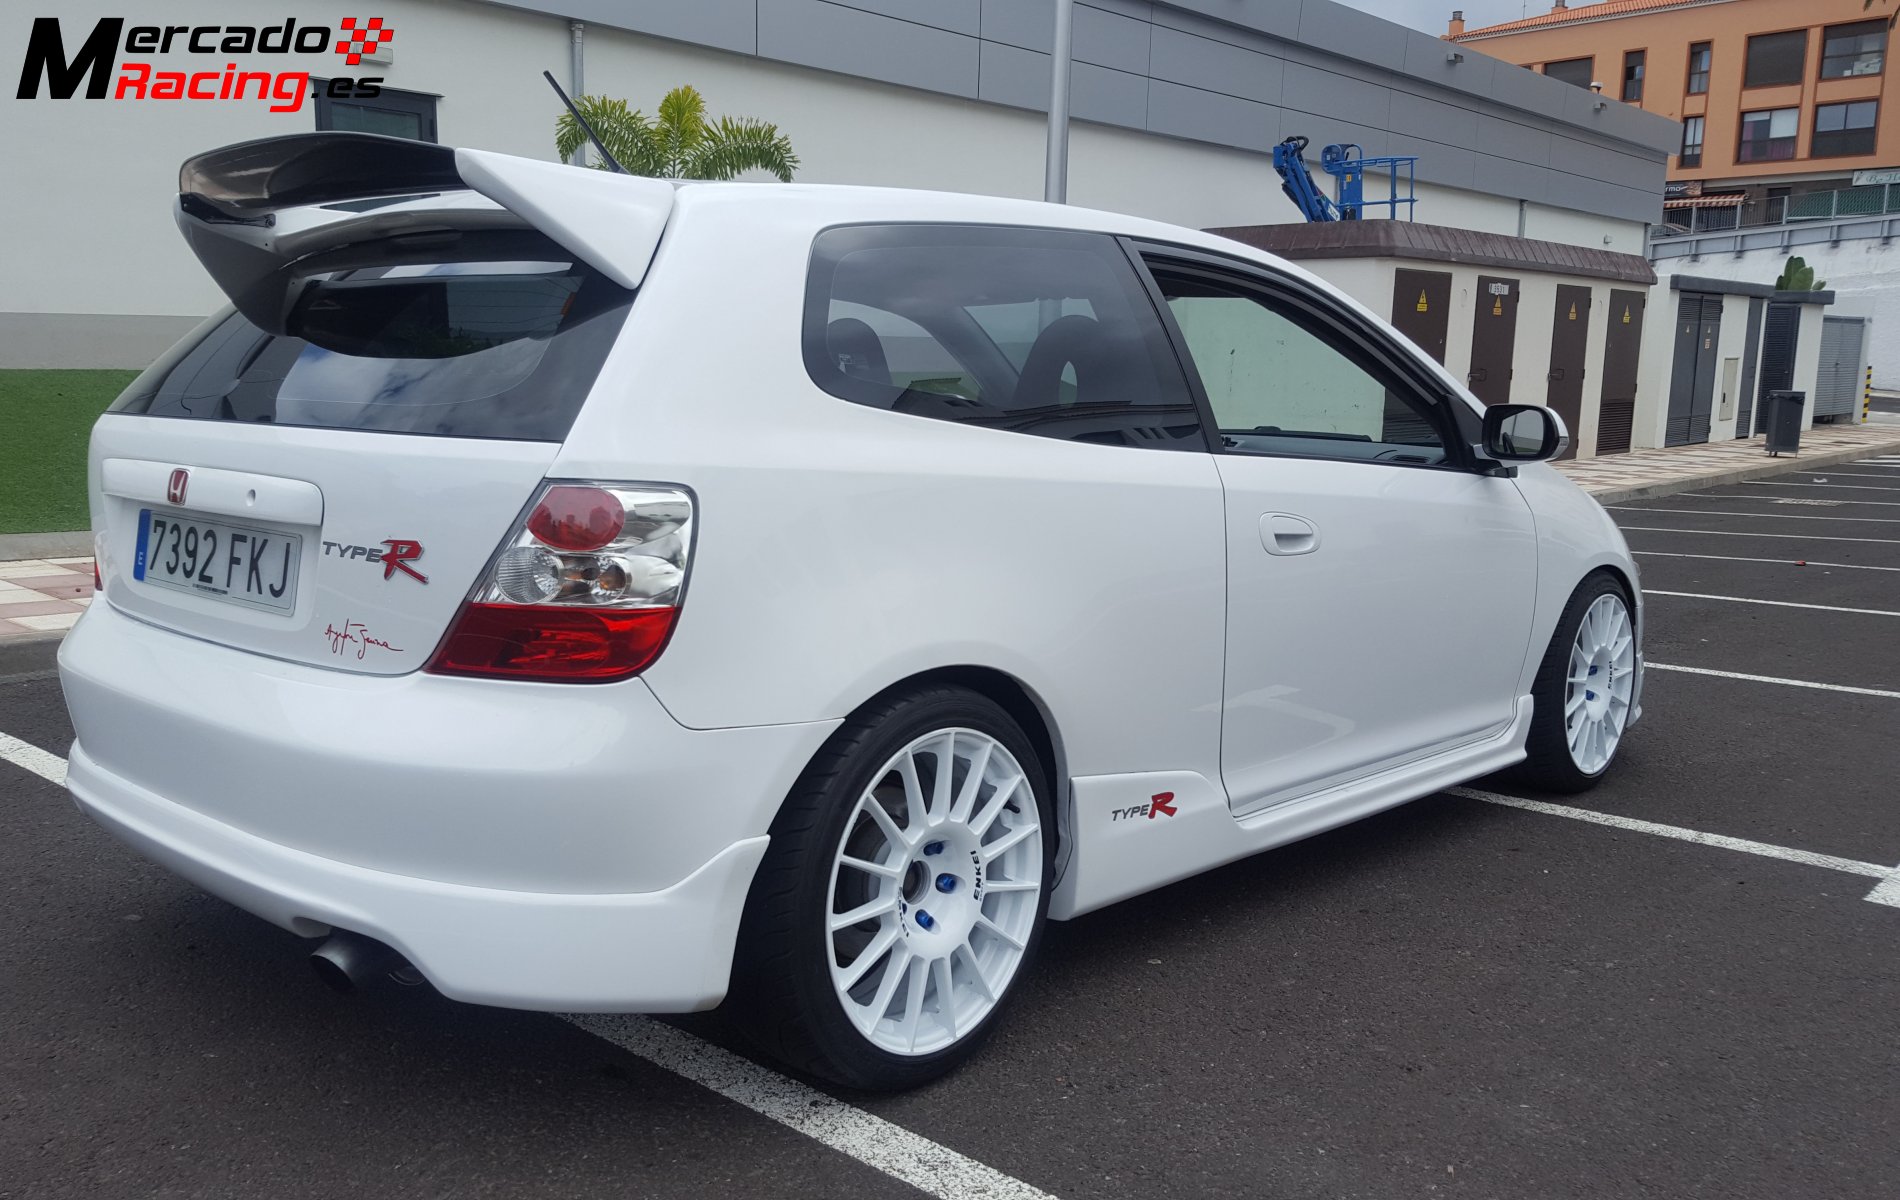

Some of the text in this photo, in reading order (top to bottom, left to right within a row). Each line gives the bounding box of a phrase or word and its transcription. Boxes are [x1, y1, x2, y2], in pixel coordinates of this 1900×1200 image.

[149, 519, 291, 598] 7392 FKJ
[969, 850, 982, 901] ENKEI
